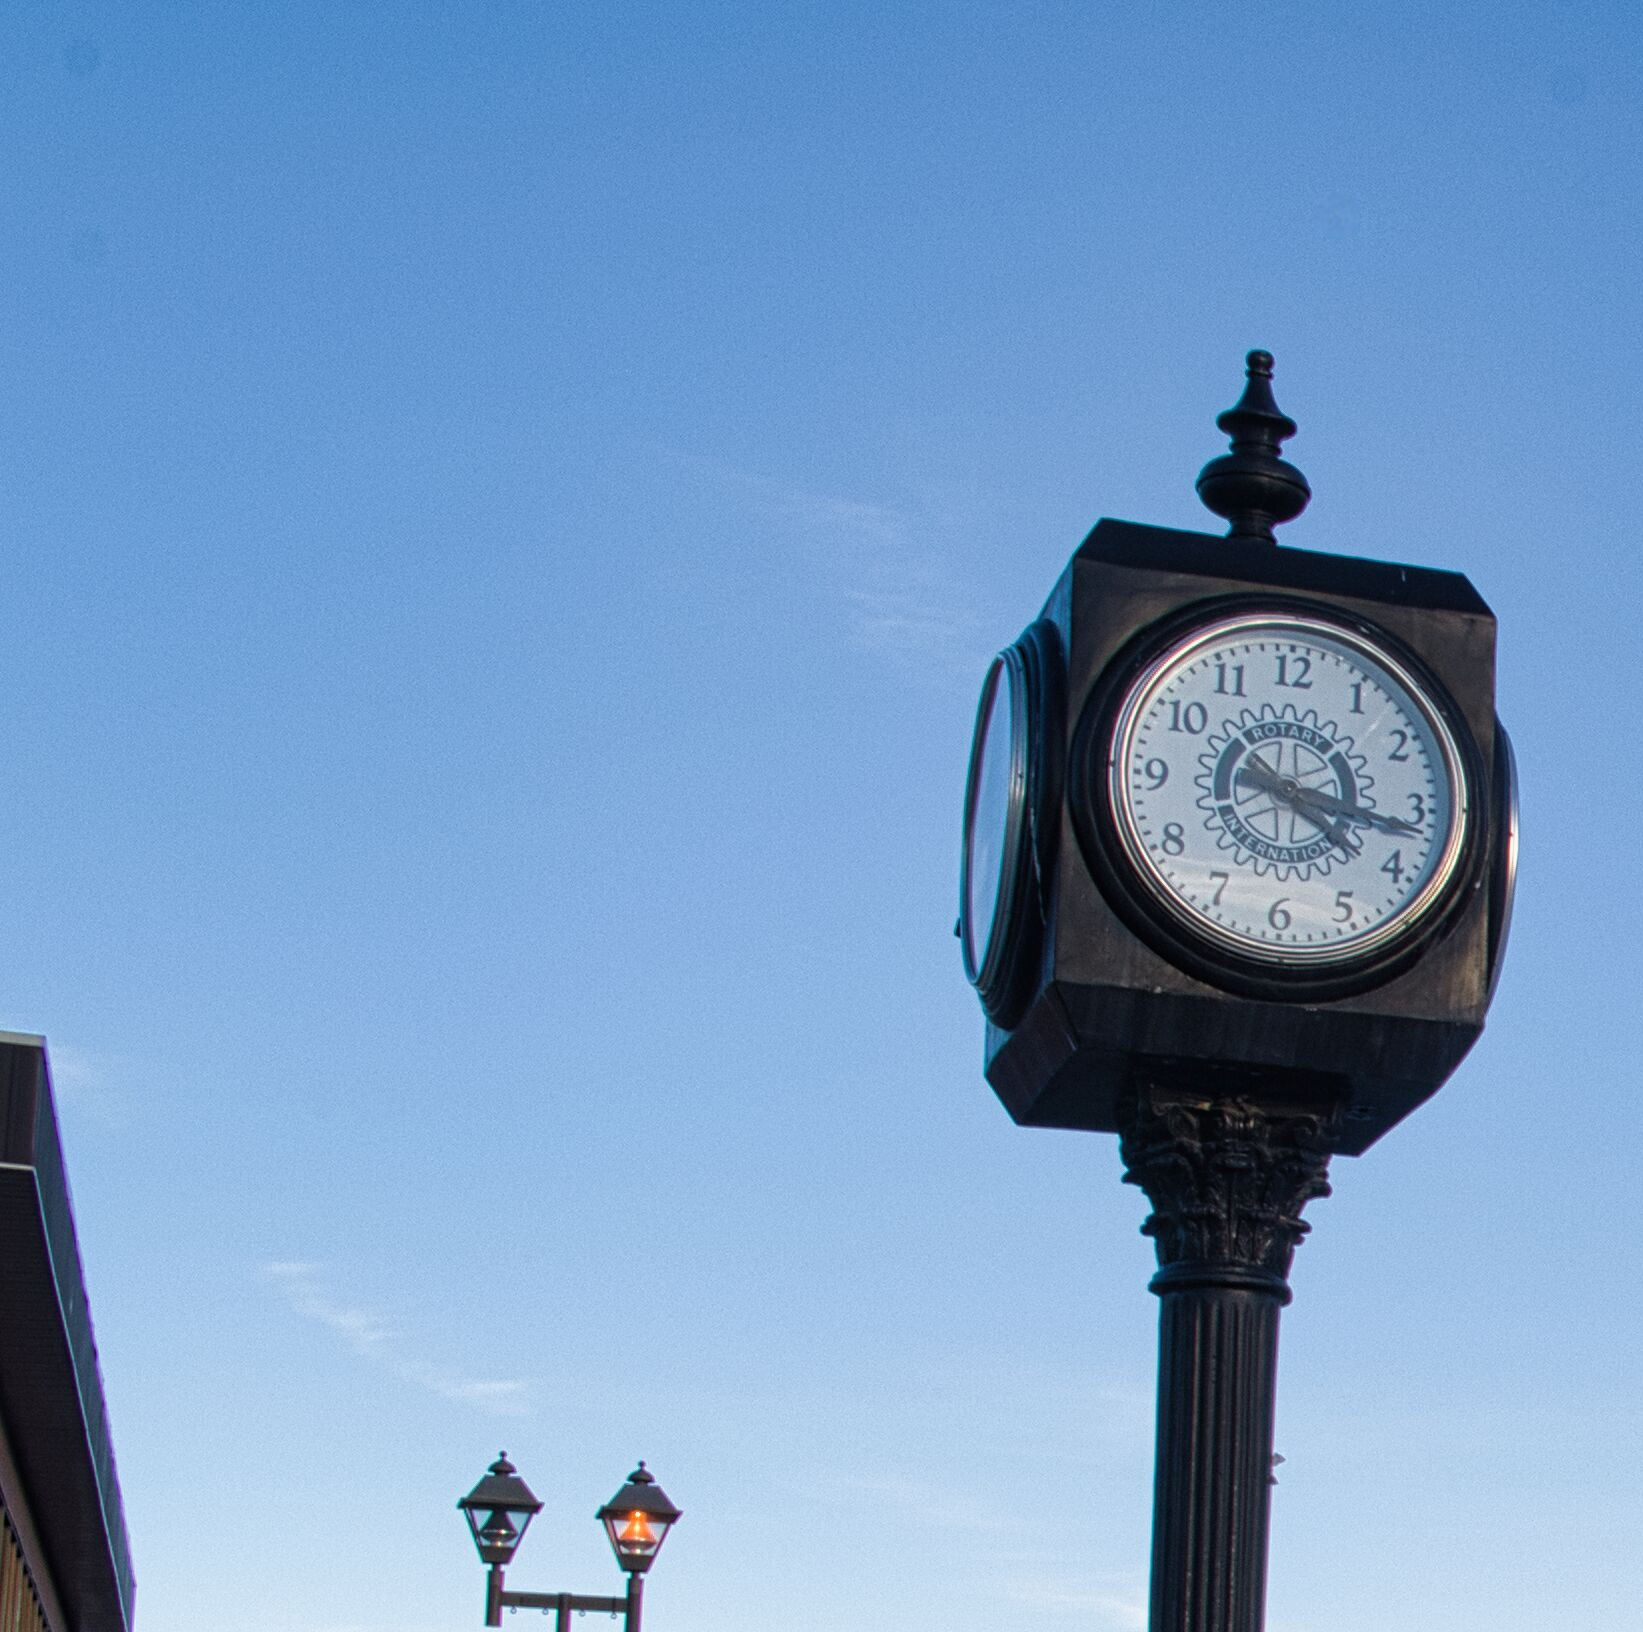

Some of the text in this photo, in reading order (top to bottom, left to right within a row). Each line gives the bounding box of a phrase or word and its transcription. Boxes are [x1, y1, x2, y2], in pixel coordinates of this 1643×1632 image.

[1214, 663, 1247, 697] 11
[1276, 655, 1313, 689] 12
[1350, 683, 1365, 715] 1
[1169, 700, 1208, 735] 10
[1251, 724, 1326, 747] ROTARY
[1389, 729, 1410, 762] 2
[1145, 758, 1169, 790] 9
[1405, 793, 1426, 825] 3
[1161, 822, 1185, 856] 8
[1222, 811, 1342, 863] INTERNATION
[1381, 850, 1405, 883] 4
[1209, 872, 1229, 906] 7
[1268, 898, 1291, 930] 6
[1332, 891, 1354, 923] 5
